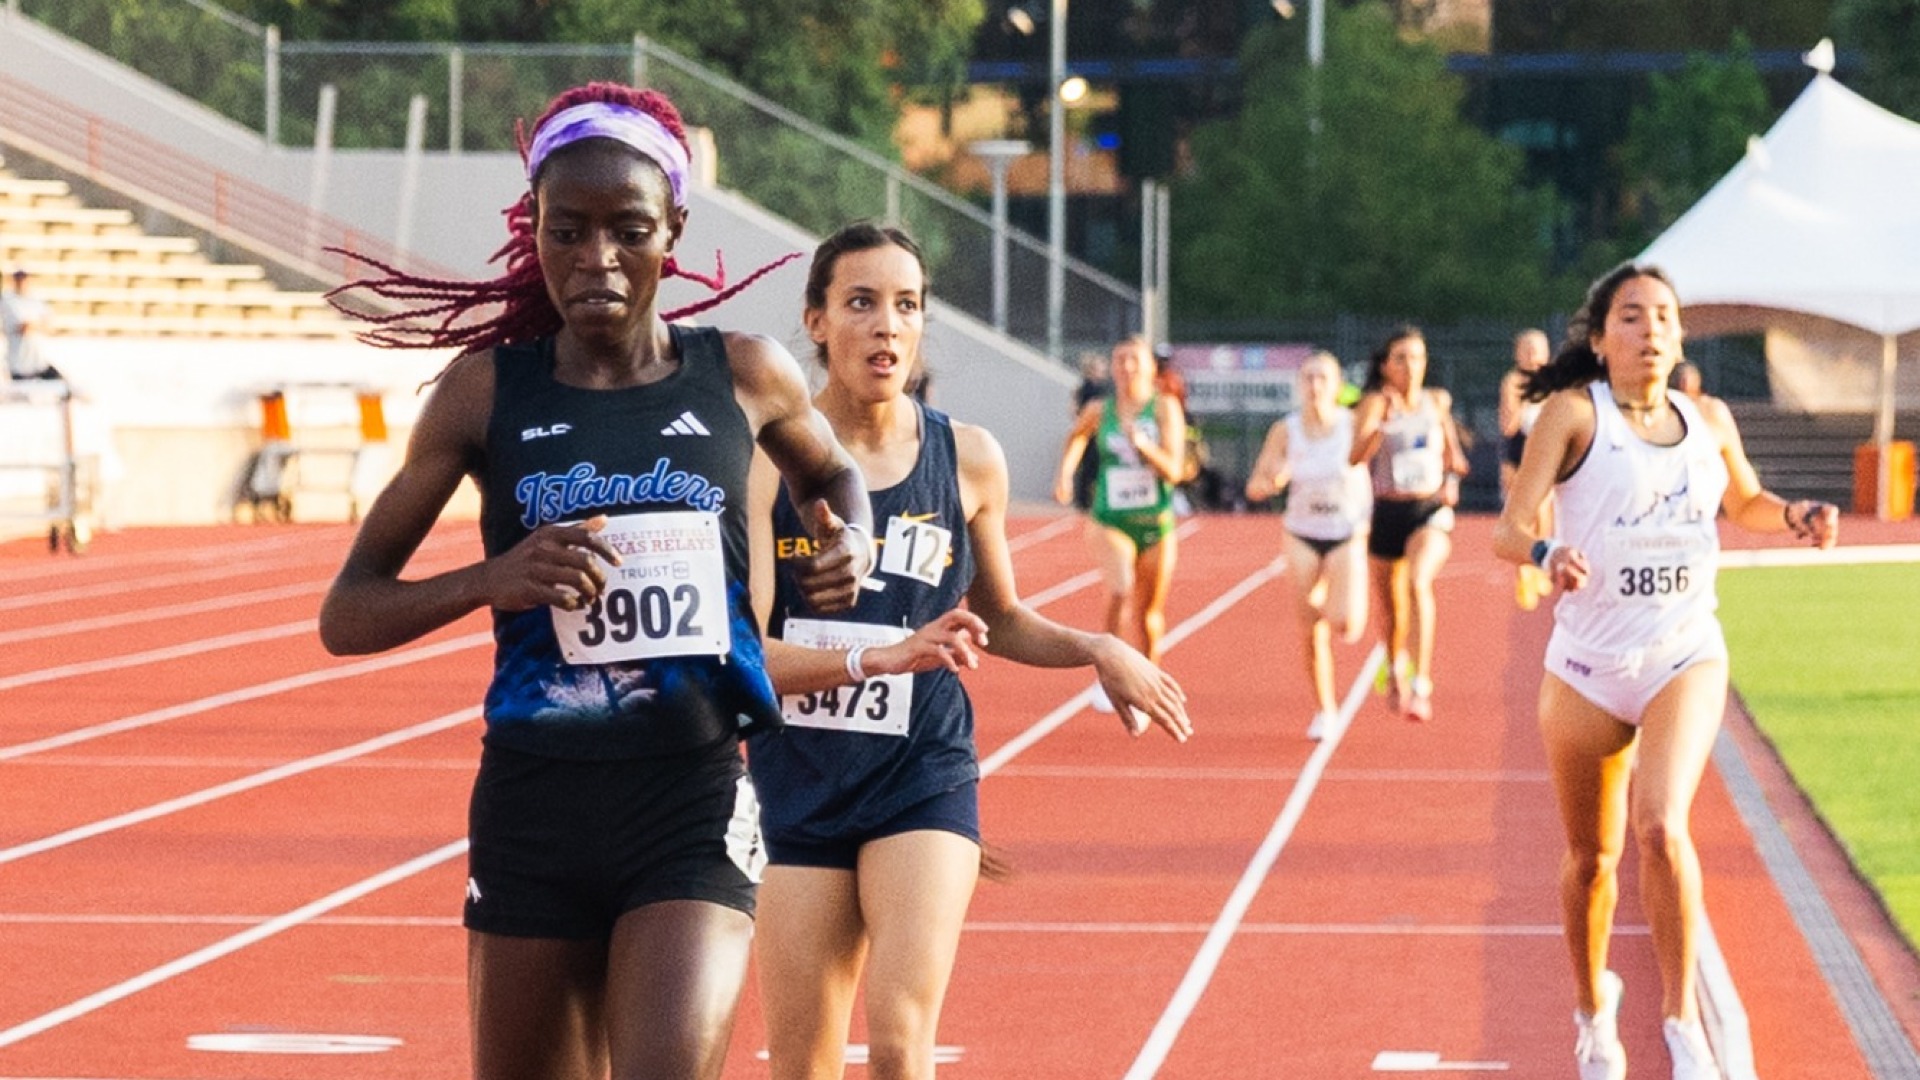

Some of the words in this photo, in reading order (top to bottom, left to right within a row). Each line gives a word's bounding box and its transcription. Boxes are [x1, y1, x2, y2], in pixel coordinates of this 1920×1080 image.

[522, 423, 572, 441] SLC
[516, 457, 724, 529] Islanders
[612, 540, 647, 555] XAS
[652, 538, 716, 553] RELAYS
[902, 526, 941, 579] 12
[620, 565, 669, 580] TRUIST
[1619, 566, 1690, 596] 3856
[578, 584, 703, 647] 3902
